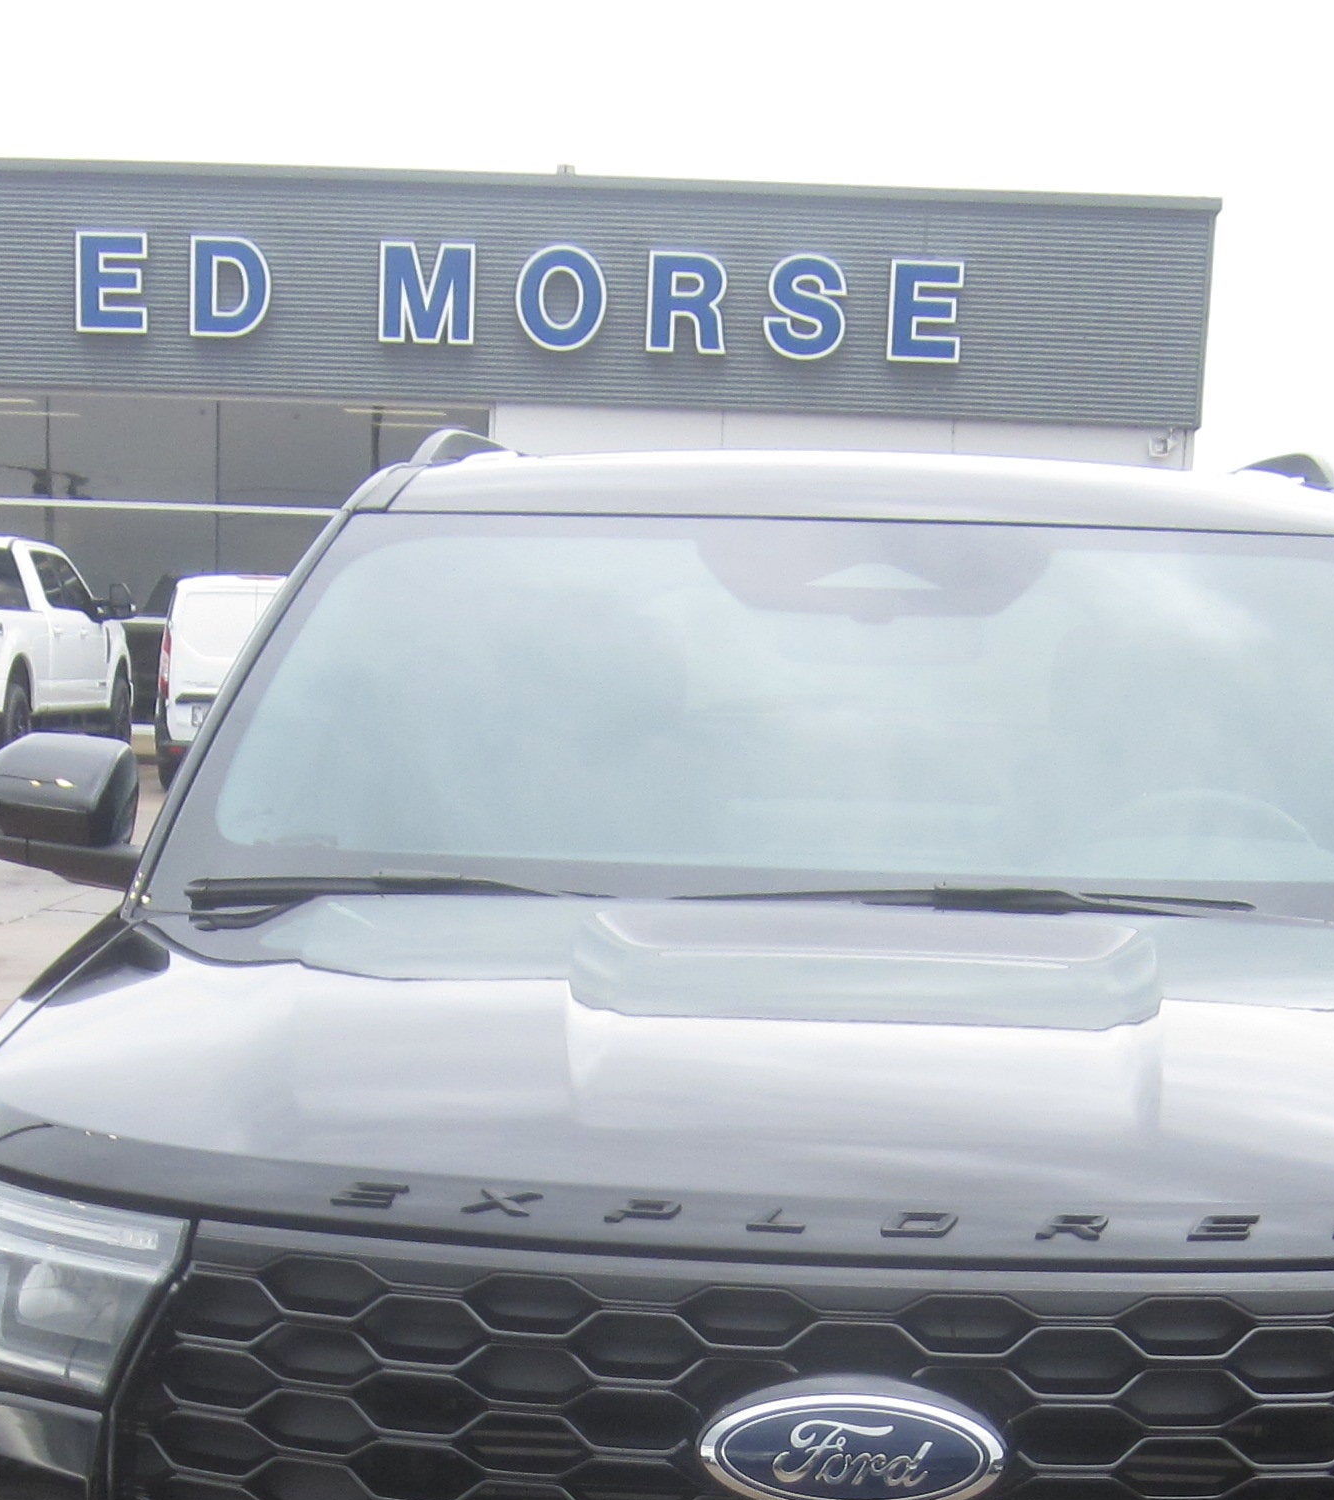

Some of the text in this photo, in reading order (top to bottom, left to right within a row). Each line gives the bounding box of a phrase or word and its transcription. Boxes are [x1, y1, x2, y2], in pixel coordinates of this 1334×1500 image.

[74, 231, 965, 364] ED MORSE
[772, 1419, 934, 1488] Ford
